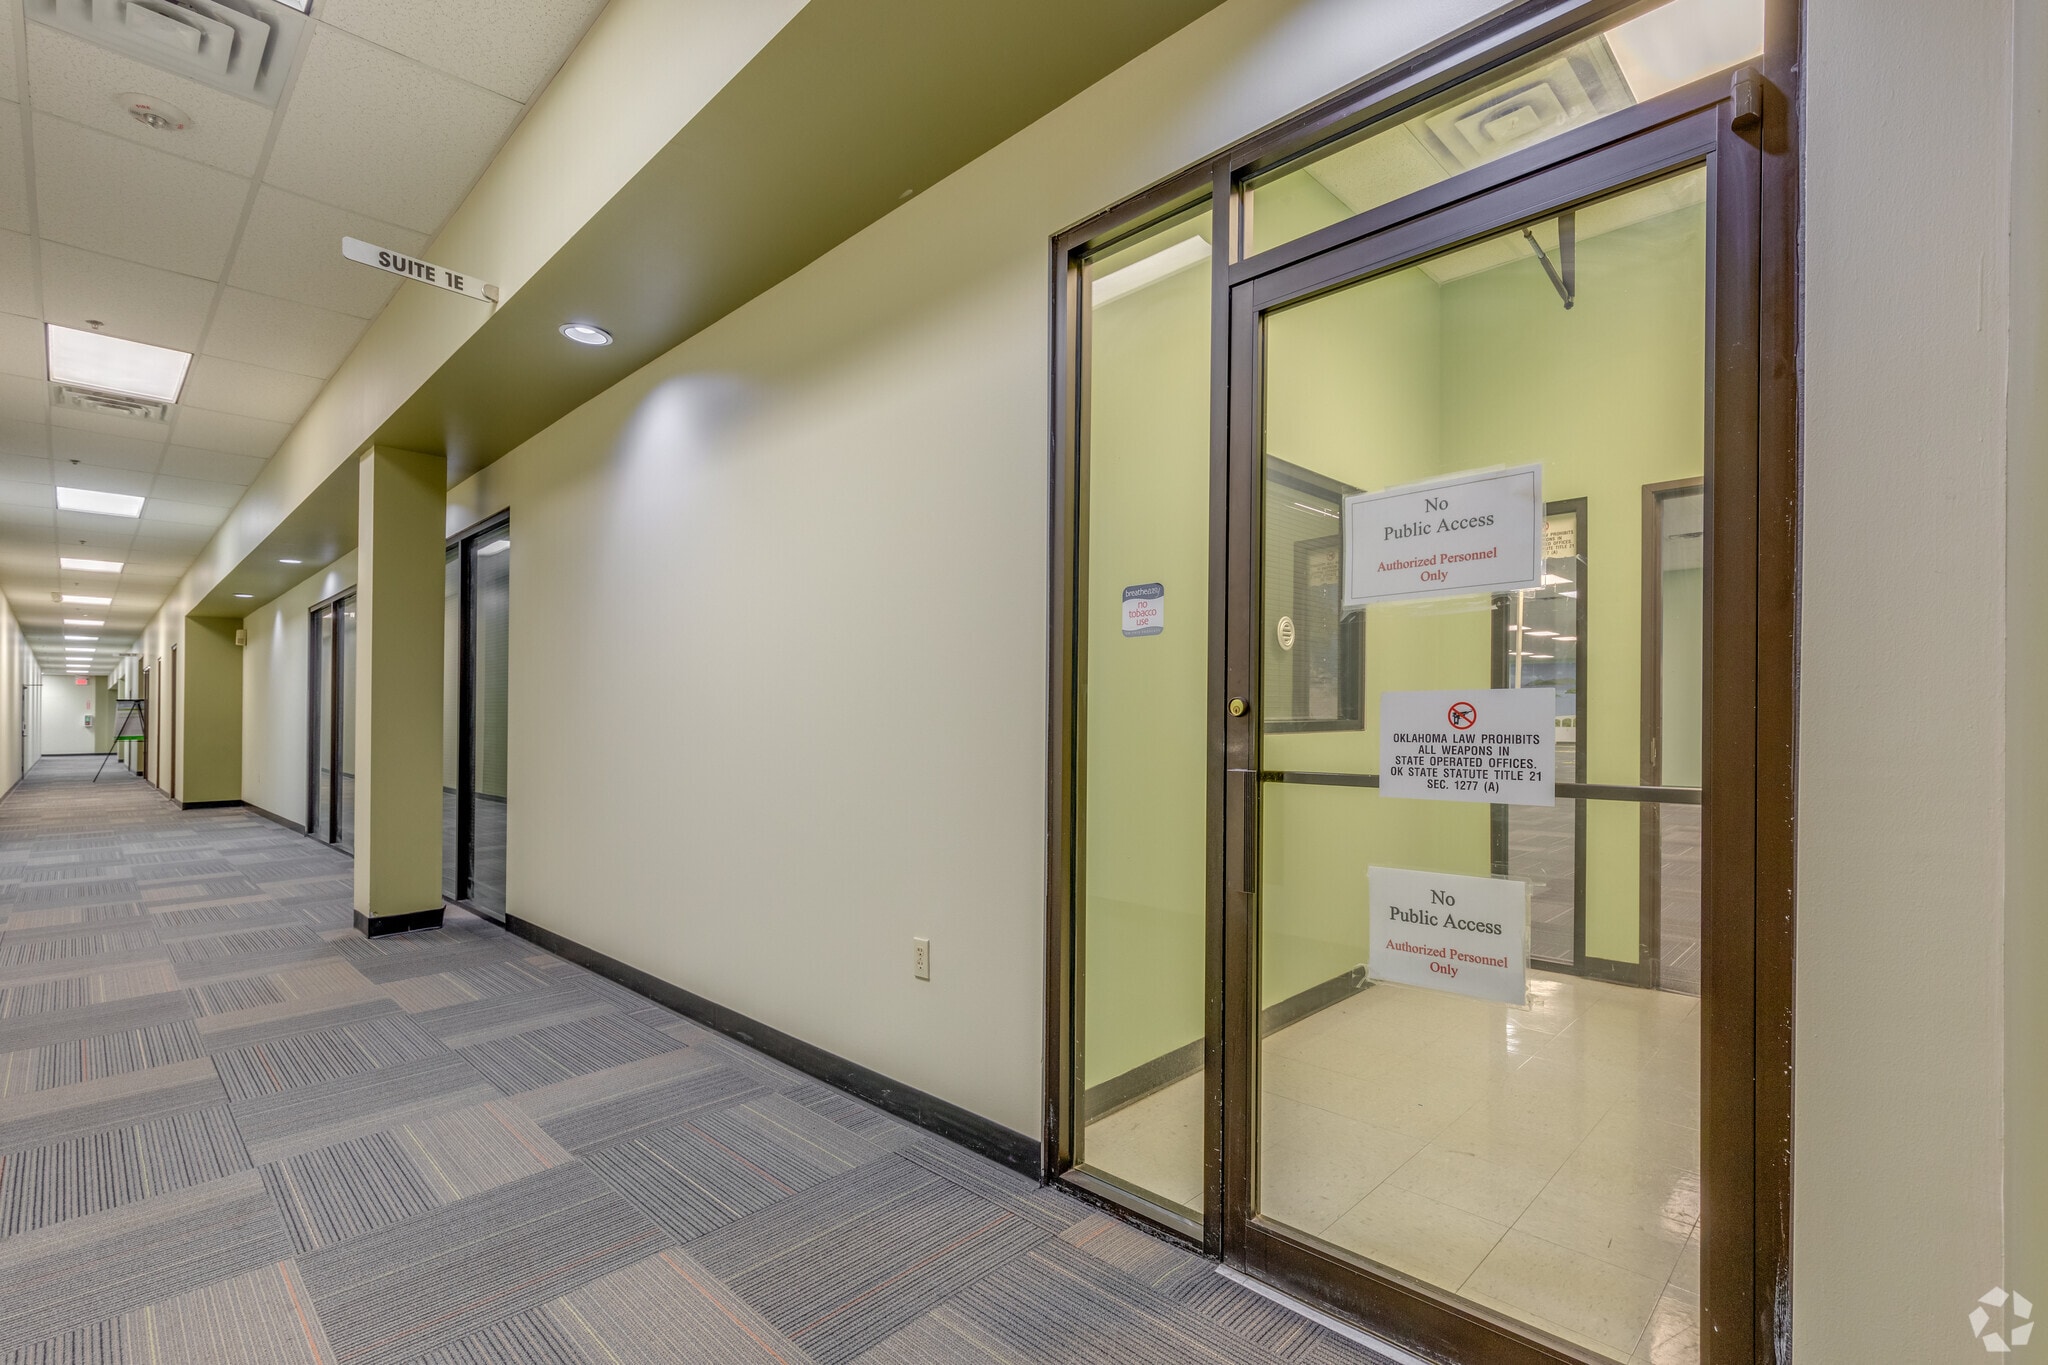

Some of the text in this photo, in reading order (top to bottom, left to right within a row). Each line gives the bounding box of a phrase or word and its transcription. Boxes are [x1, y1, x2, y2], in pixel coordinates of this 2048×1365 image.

[379, 251, 463, 291] SUITE 1E
[1425, 498, 1448, 513] No
[1384, 514, 1494, 540] Public Access
[1377, 547, 1497, 572] Authorized Personnel
[1421, 570, 1448, 582] Only
[1129, 609, 1156, 618] tobacco
[1393, 733, 1540, 744] OKLAHOMA LAW PROHIBITS
[1418, 745, 1509, 756] ALL WEAPONS IN
[1395, 756, 1537, 769] STATE OPERATED OFFICES.
[1391, 767, 1542, 781] OK STATE STATUTE TITLE 21
[1427, 780, 1499, 793] SEC. 1277 (A)
[1430, 890, 1455, 906] No
[1390, 906, 1502, 935] Public Access
[1386, 939, 1508, 968] Authorized Personnel
[1430, 962, 1458, 978] Only
